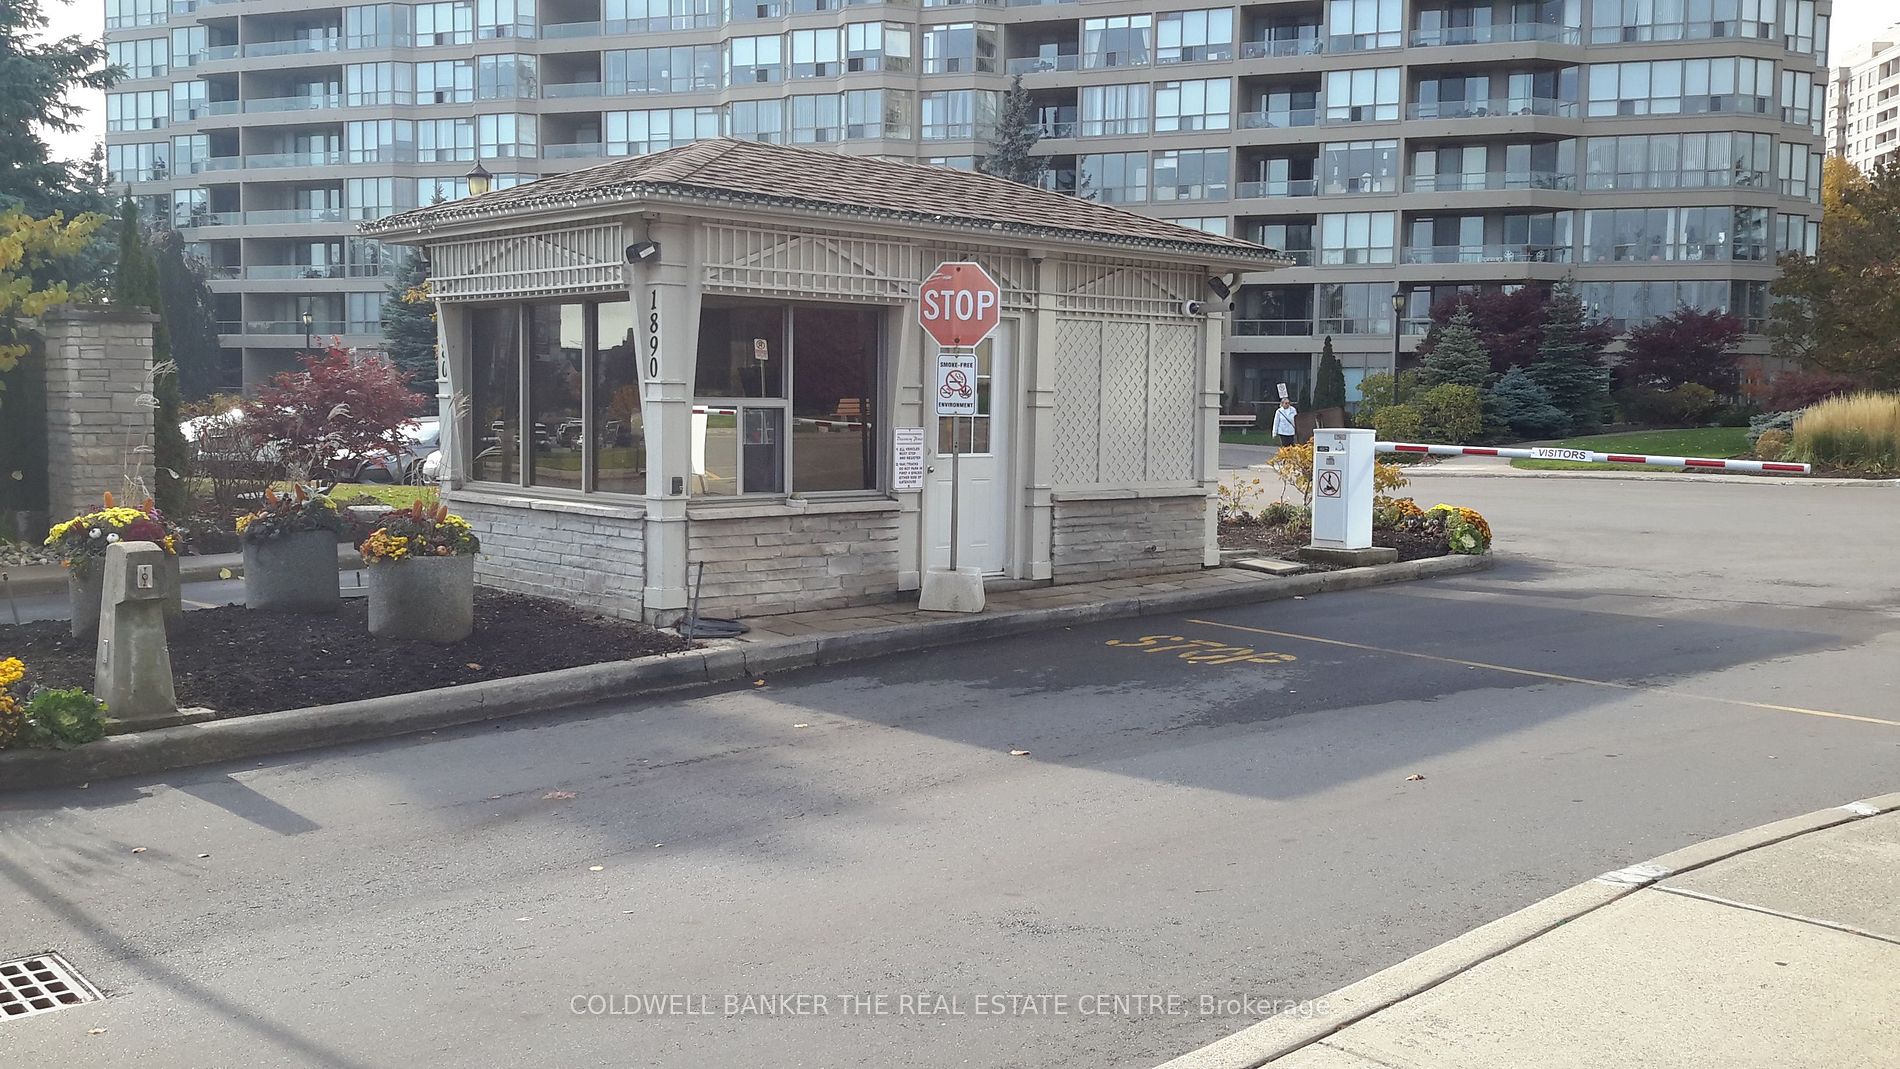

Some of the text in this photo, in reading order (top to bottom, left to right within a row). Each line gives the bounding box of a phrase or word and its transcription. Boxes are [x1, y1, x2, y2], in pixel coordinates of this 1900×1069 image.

[923, 289, 995, 321] STOP
[650, 289, 658, 378] 1890
[940, 361, 973, 369] SMOKE-FREE
[1538, 448, 1586, 460] VISITORS
[1105, 635, 1297, 665] STOP
